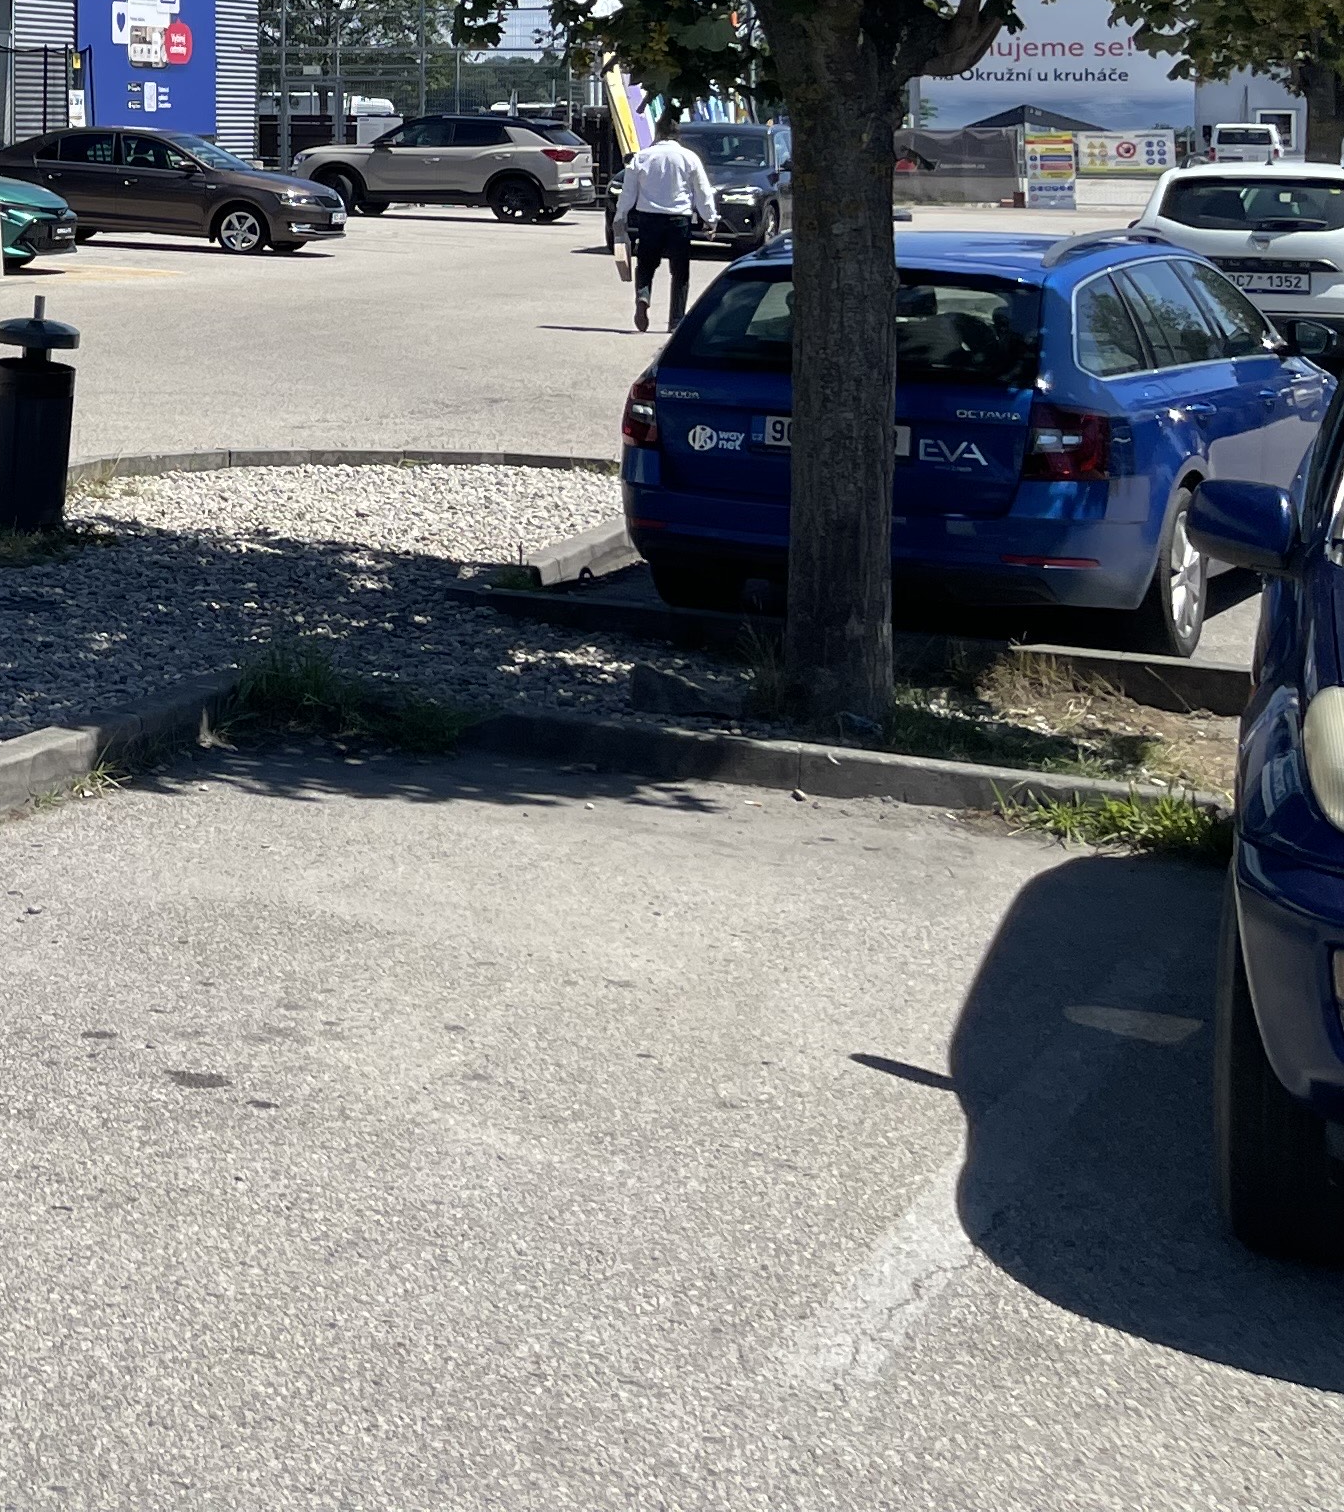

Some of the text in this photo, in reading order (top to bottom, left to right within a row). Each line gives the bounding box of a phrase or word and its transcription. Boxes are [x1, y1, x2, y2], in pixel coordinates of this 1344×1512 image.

[1094, 37, 1134, 57] se!
[960, 67, 1031, 83] Okružní
[1038, 71, 1049, 82] u
[1053, 67, 1129, 82] kruháče
[1266, 275, 1302, 288] 1352
[956, 409, 1022, 421] OCTAVIA
[718, 430, 745, 443] way
[718, 440, 742, 451] net
[919, 438, 989, 466] EVA
